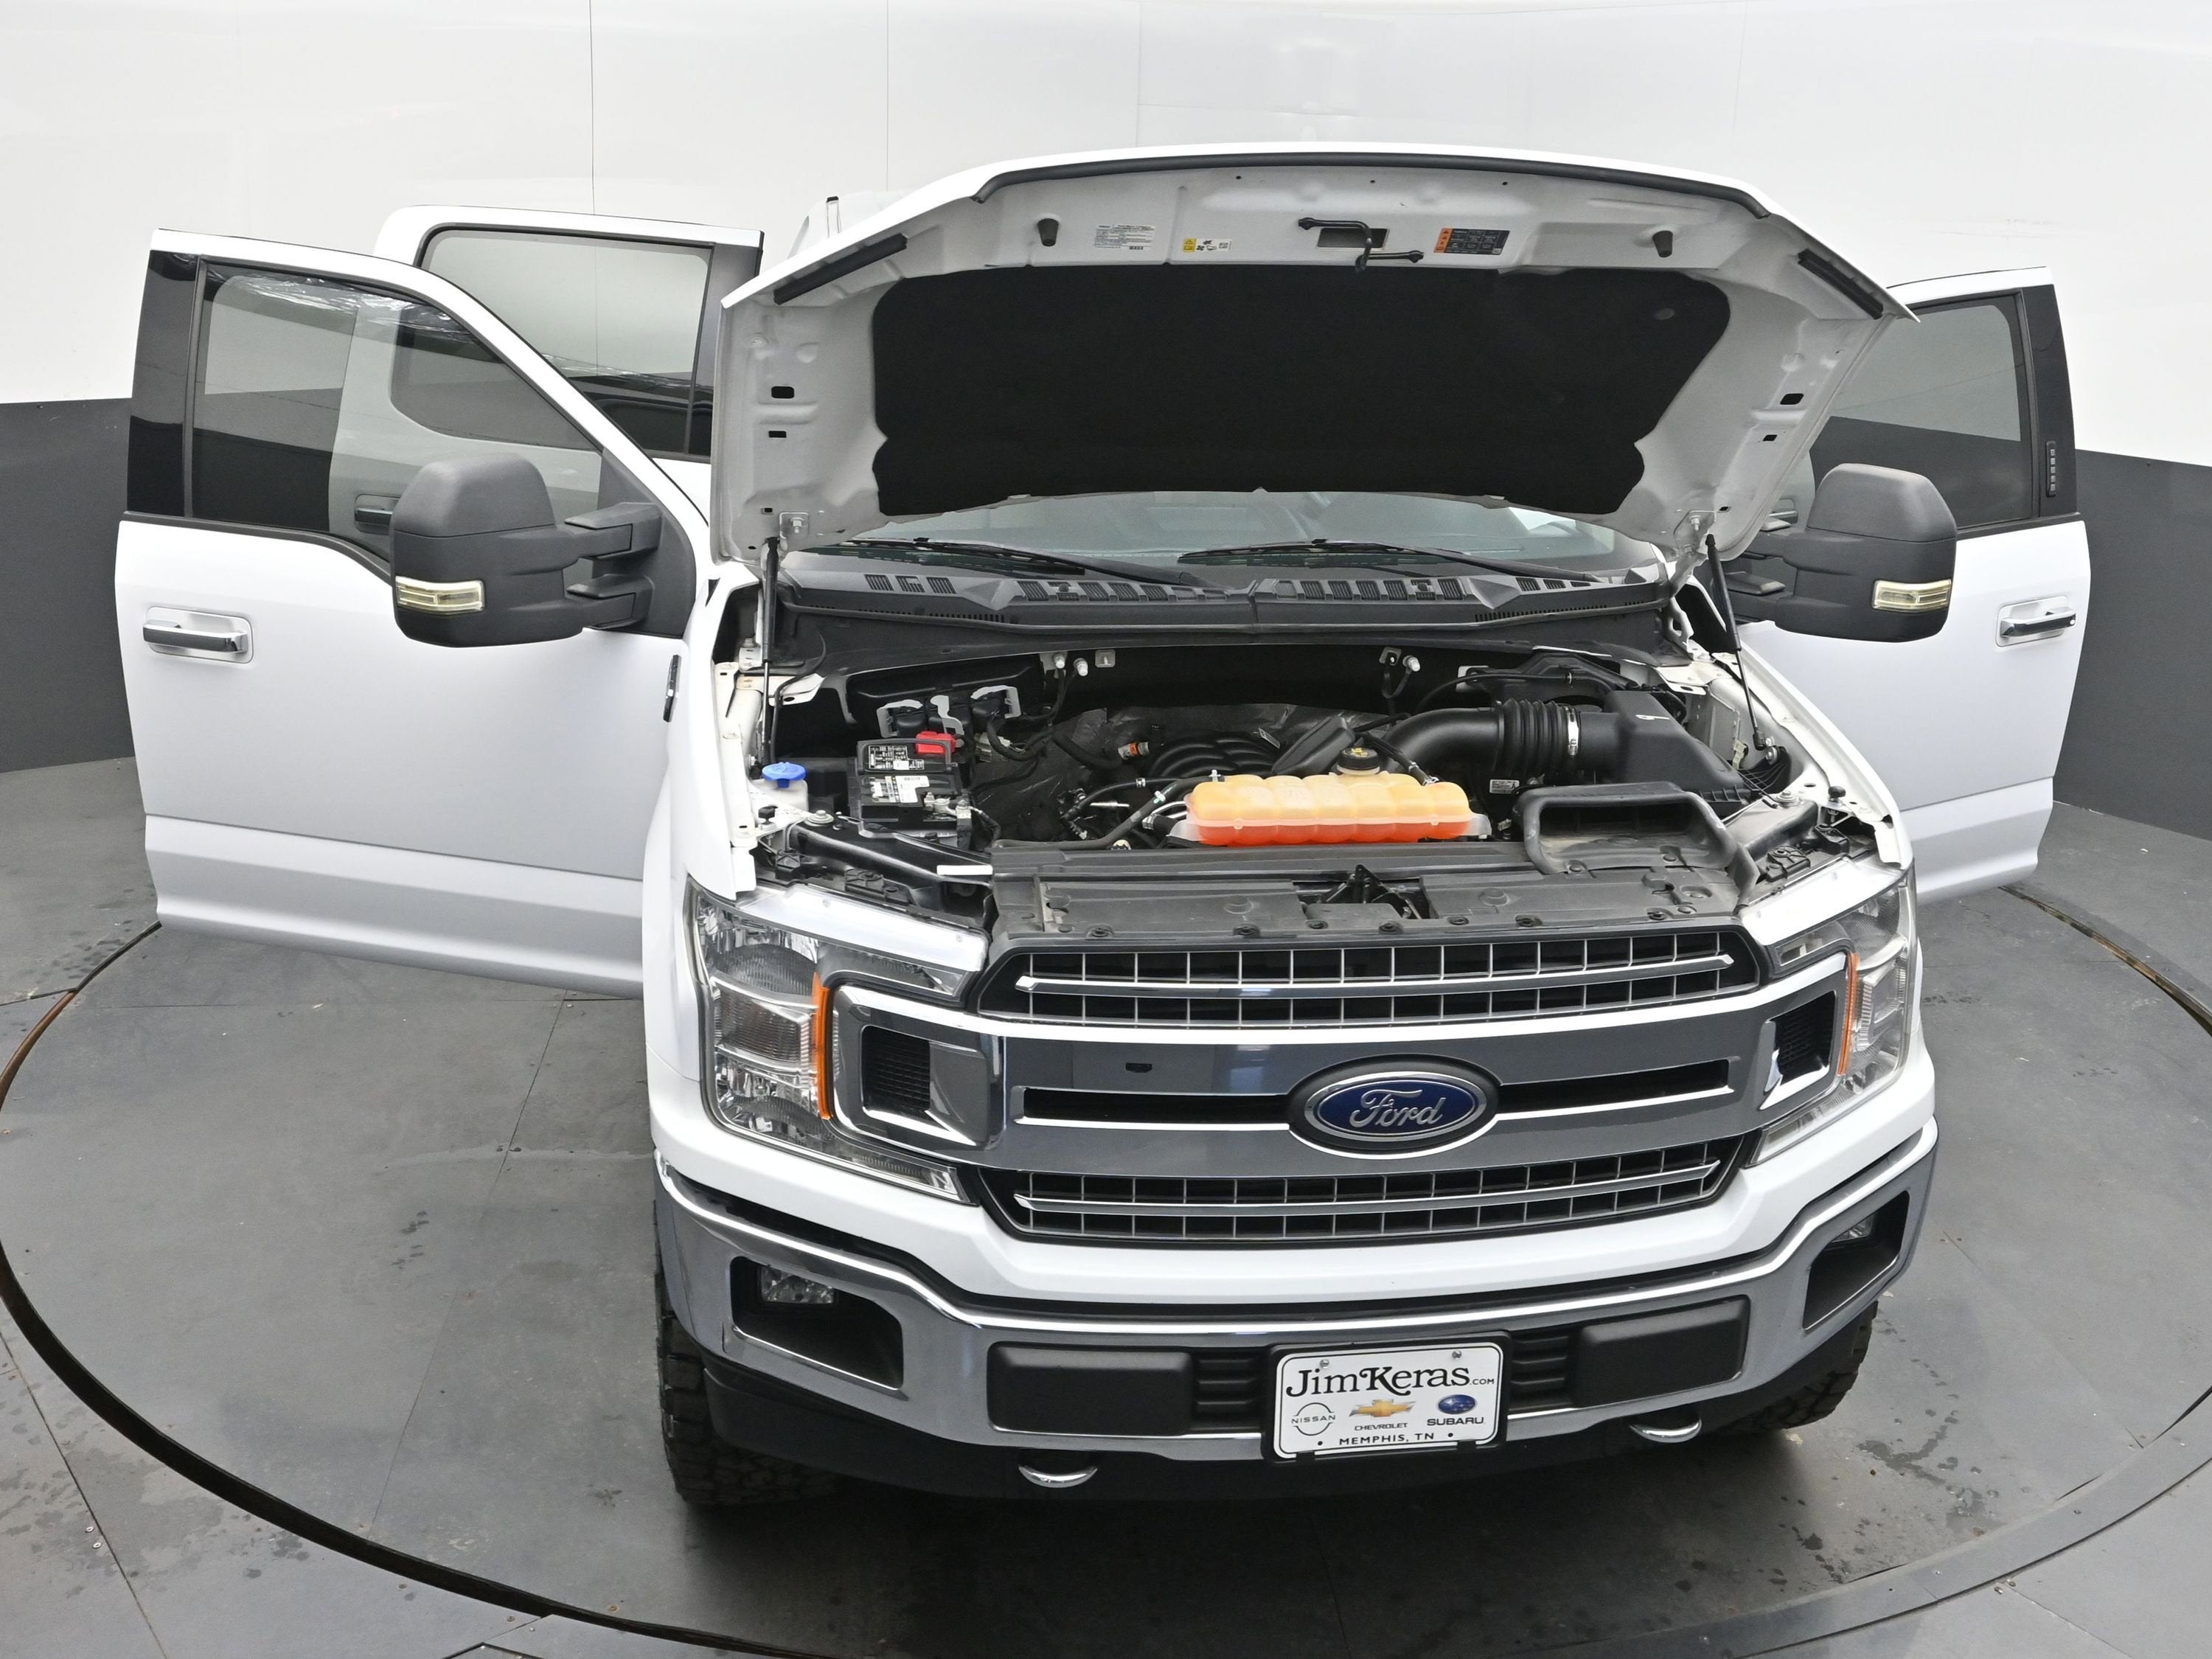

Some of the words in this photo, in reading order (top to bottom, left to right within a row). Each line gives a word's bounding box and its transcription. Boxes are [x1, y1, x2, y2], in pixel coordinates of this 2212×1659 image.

[1349, 1089, 1446, 1128] Ford
[1291, 1414, 1336, 1424] NISSAN
[1426, 1416, 1484, 1426] SUBARU
[1354, 1422, 1408, 1430] CHEVROLET
[1339, 1434, 1408, 1446] MEMPHIS,
[1414, 1432, 1434, 1441] TN
